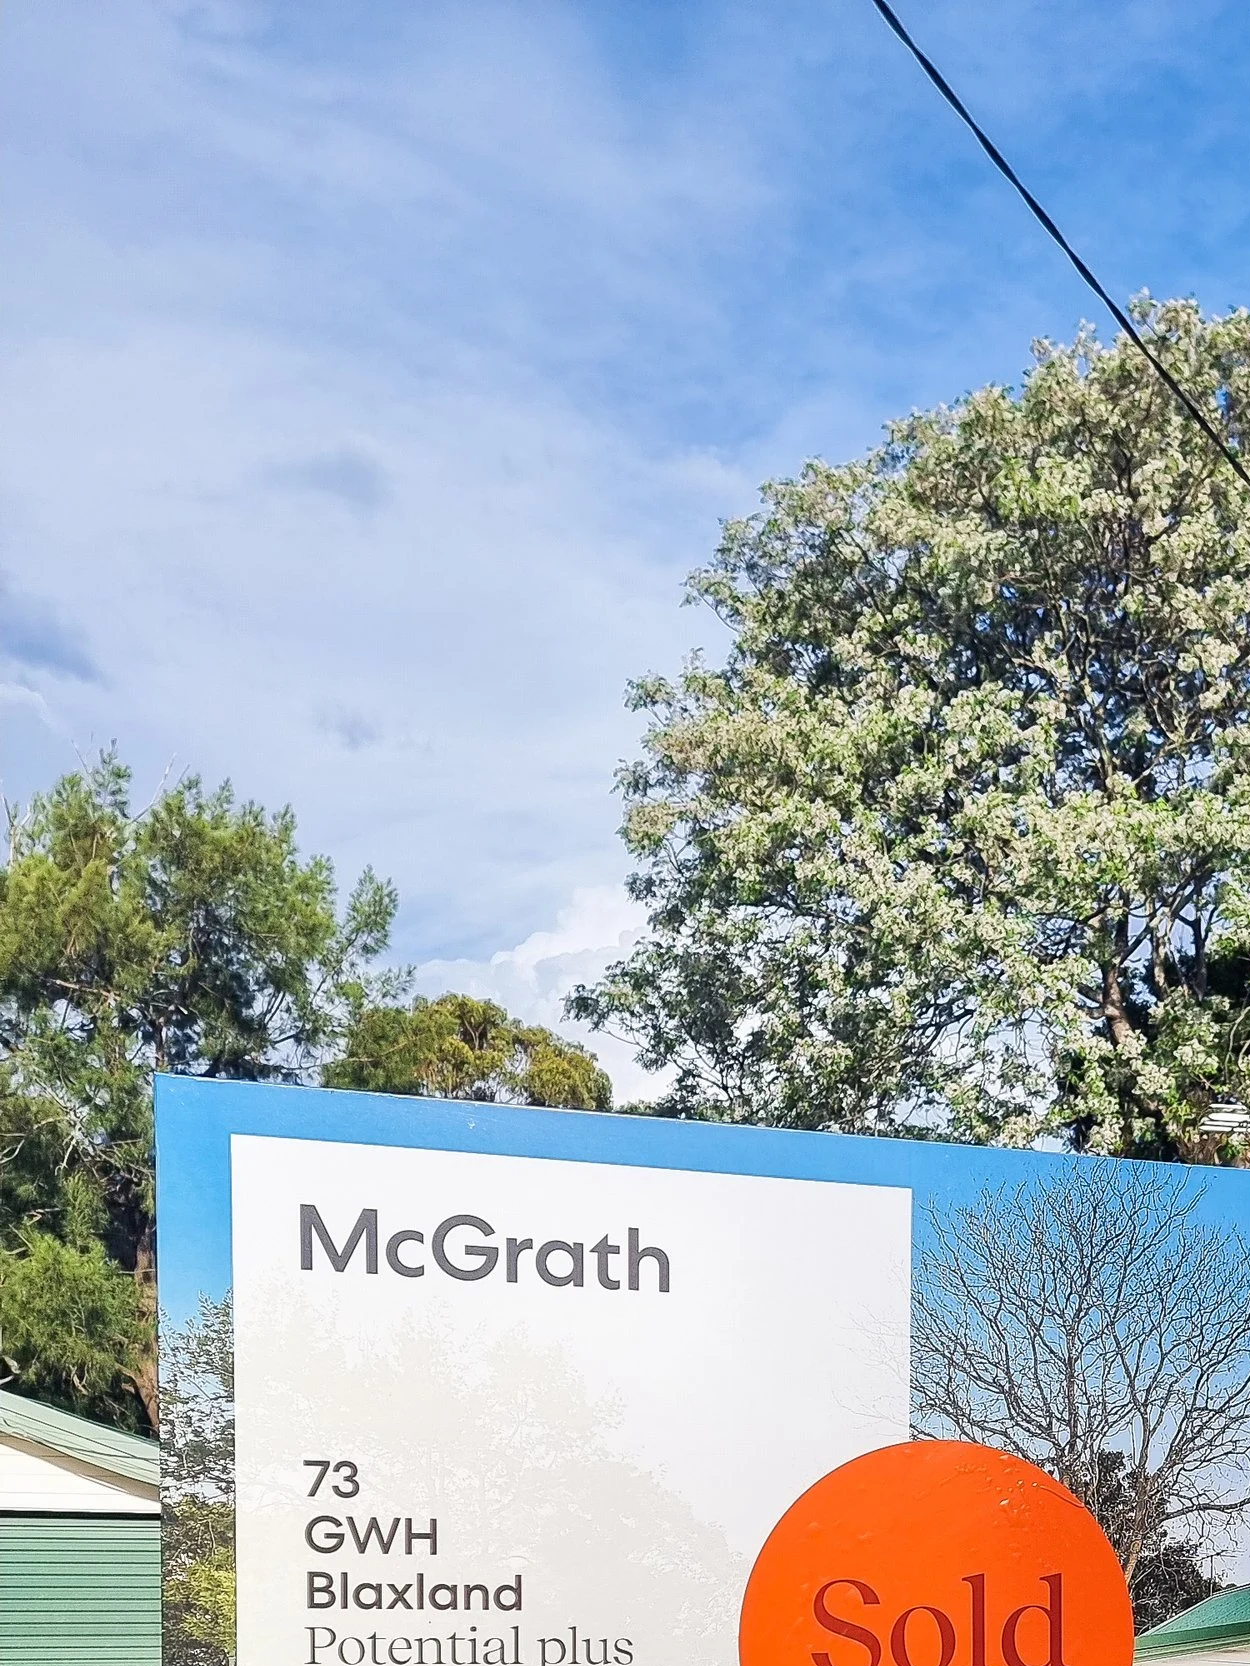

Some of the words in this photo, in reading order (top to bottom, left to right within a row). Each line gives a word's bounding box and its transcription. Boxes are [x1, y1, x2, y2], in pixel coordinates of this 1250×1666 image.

[299, 1203, 671, 1293] McGrath
[303, 1460, 360, 1499] 73
[304, 1515, 438, 1556] GWH
[307, 1571, 523, 1611] Blaxland
[304, 1625, 524, 1666] Potential
